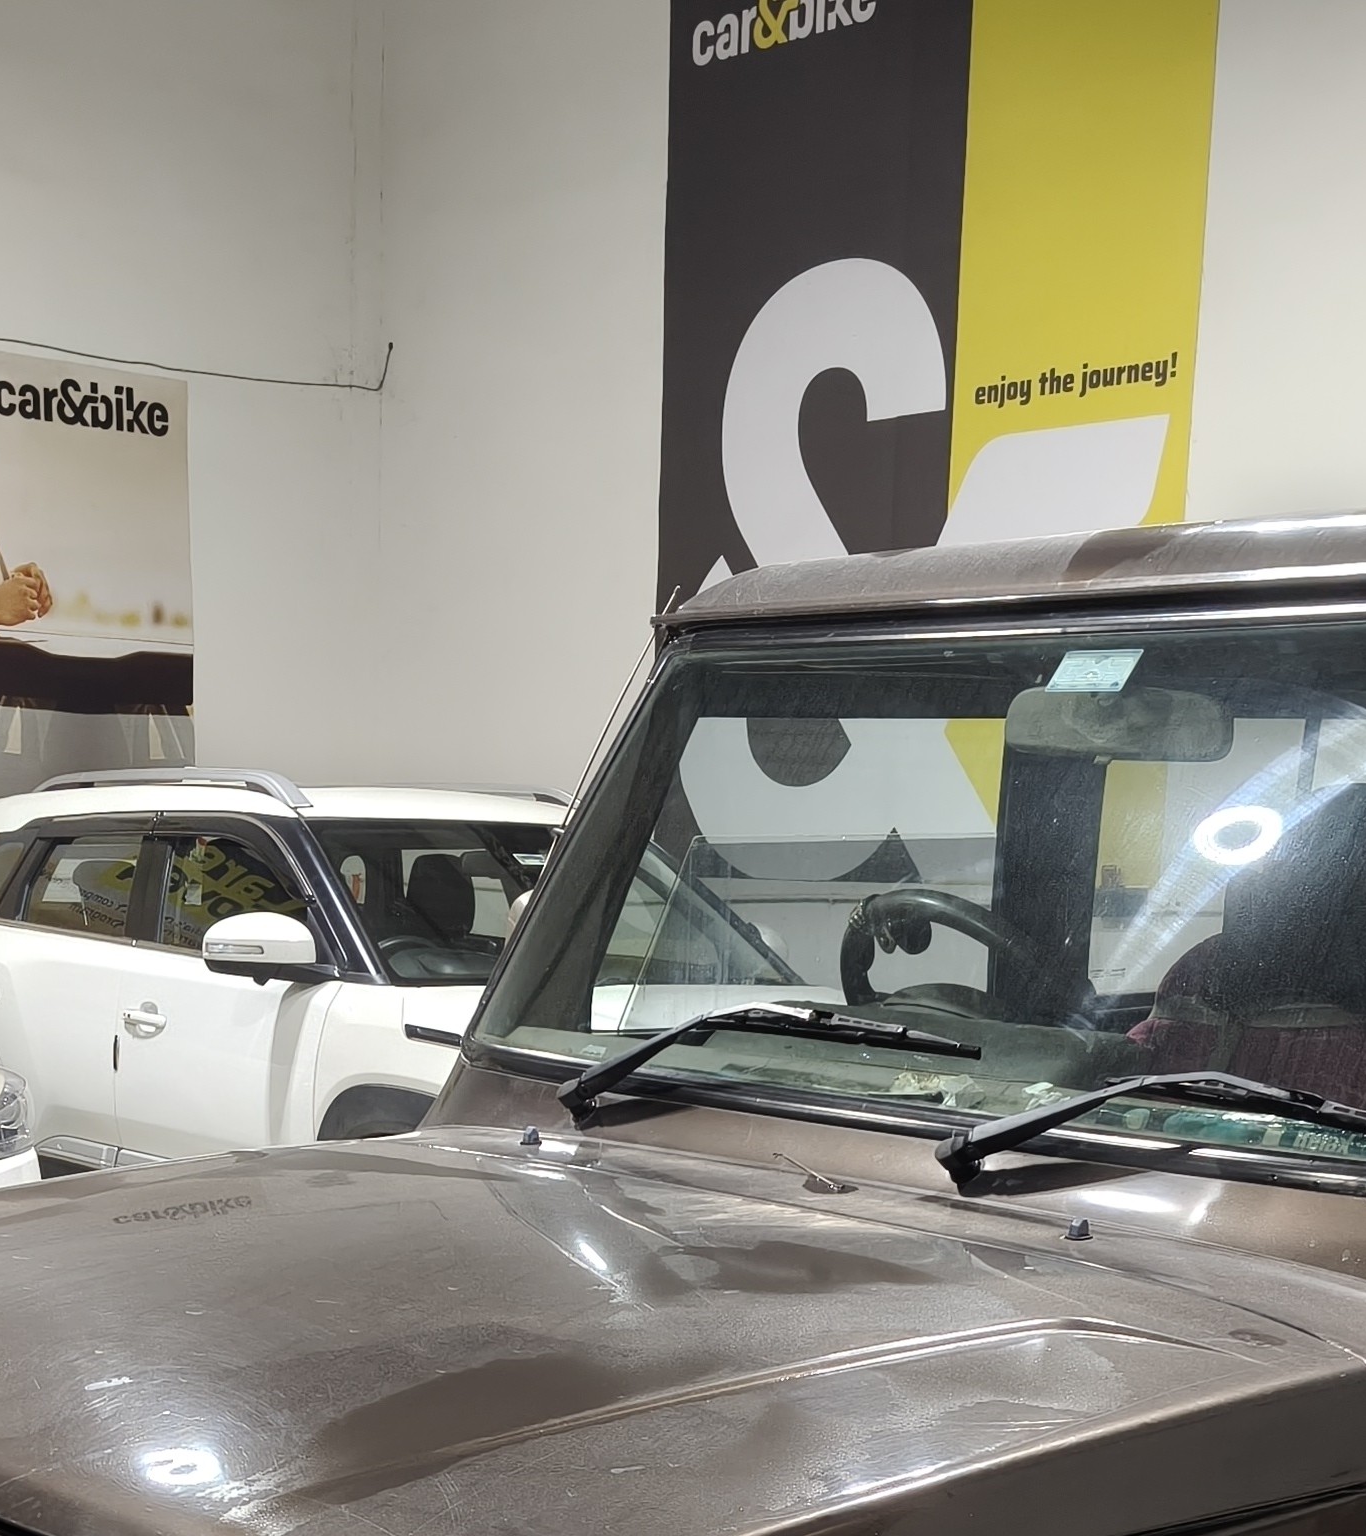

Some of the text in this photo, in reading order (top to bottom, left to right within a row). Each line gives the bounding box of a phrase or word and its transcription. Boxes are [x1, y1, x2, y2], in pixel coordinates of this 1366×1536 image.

[974, 351, 1178, 409] enjoy the journey!
